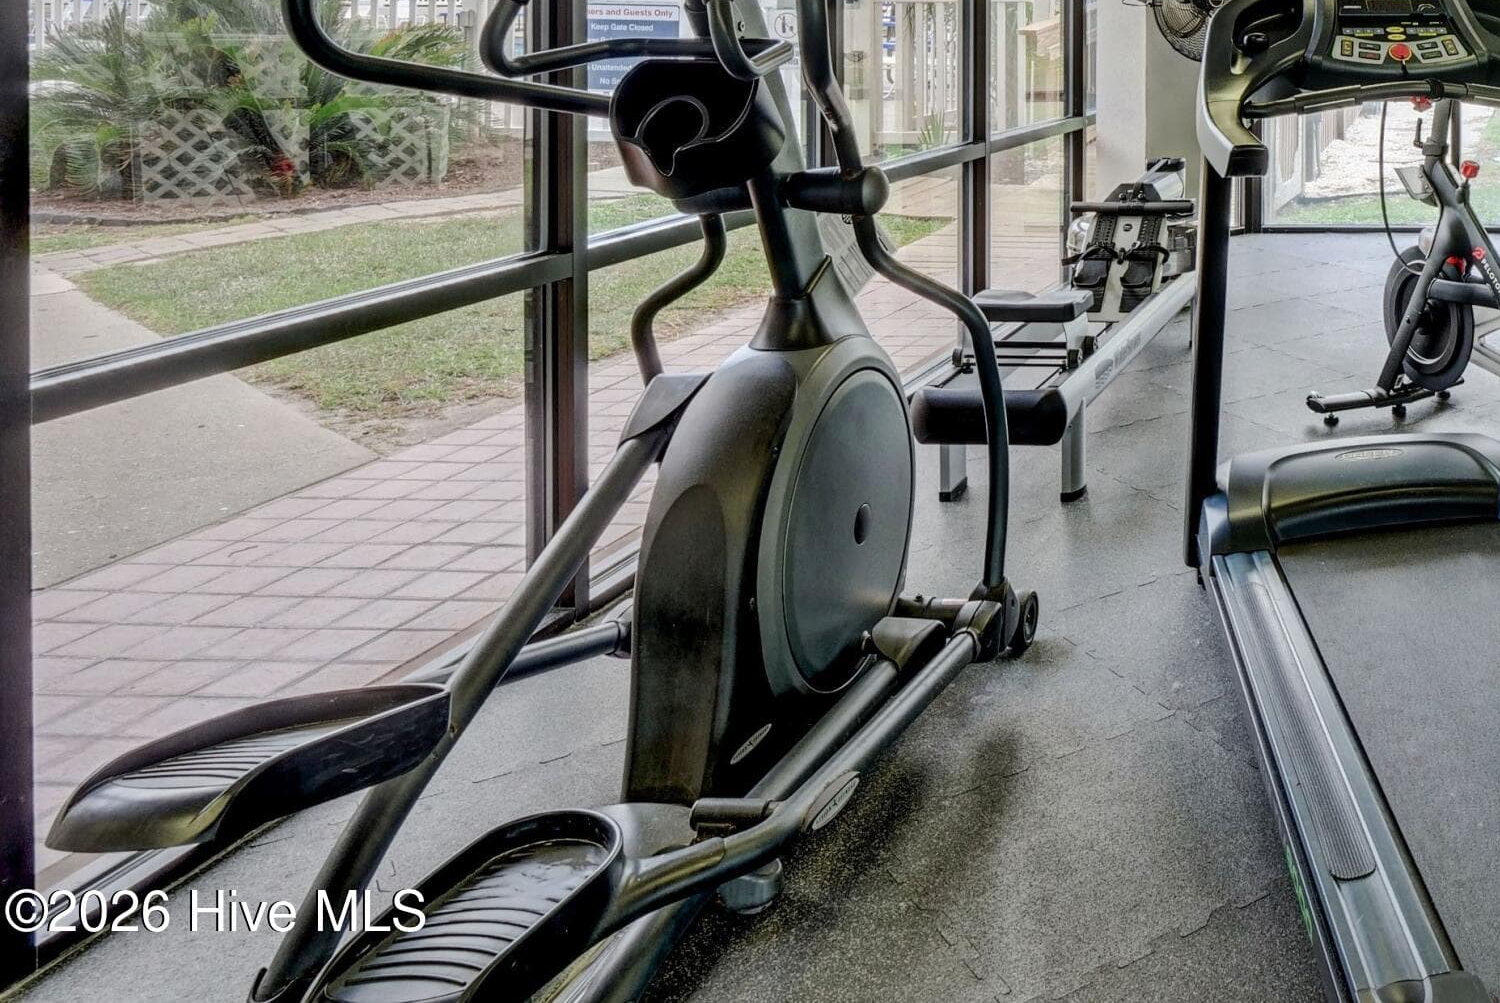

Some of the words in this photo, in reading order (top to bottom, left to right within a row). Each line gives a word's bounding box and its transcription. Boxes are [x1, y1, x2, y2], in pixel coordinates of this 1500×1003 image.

[605, 8, 621, 16] and
[623, 8, 652, 17] Guests
[654, 9, 673, 18] Only
[591, 22, 610, 32] Keep
[610, 22, 628, 31] Gate
[628, 23, 654, 32] Closed
